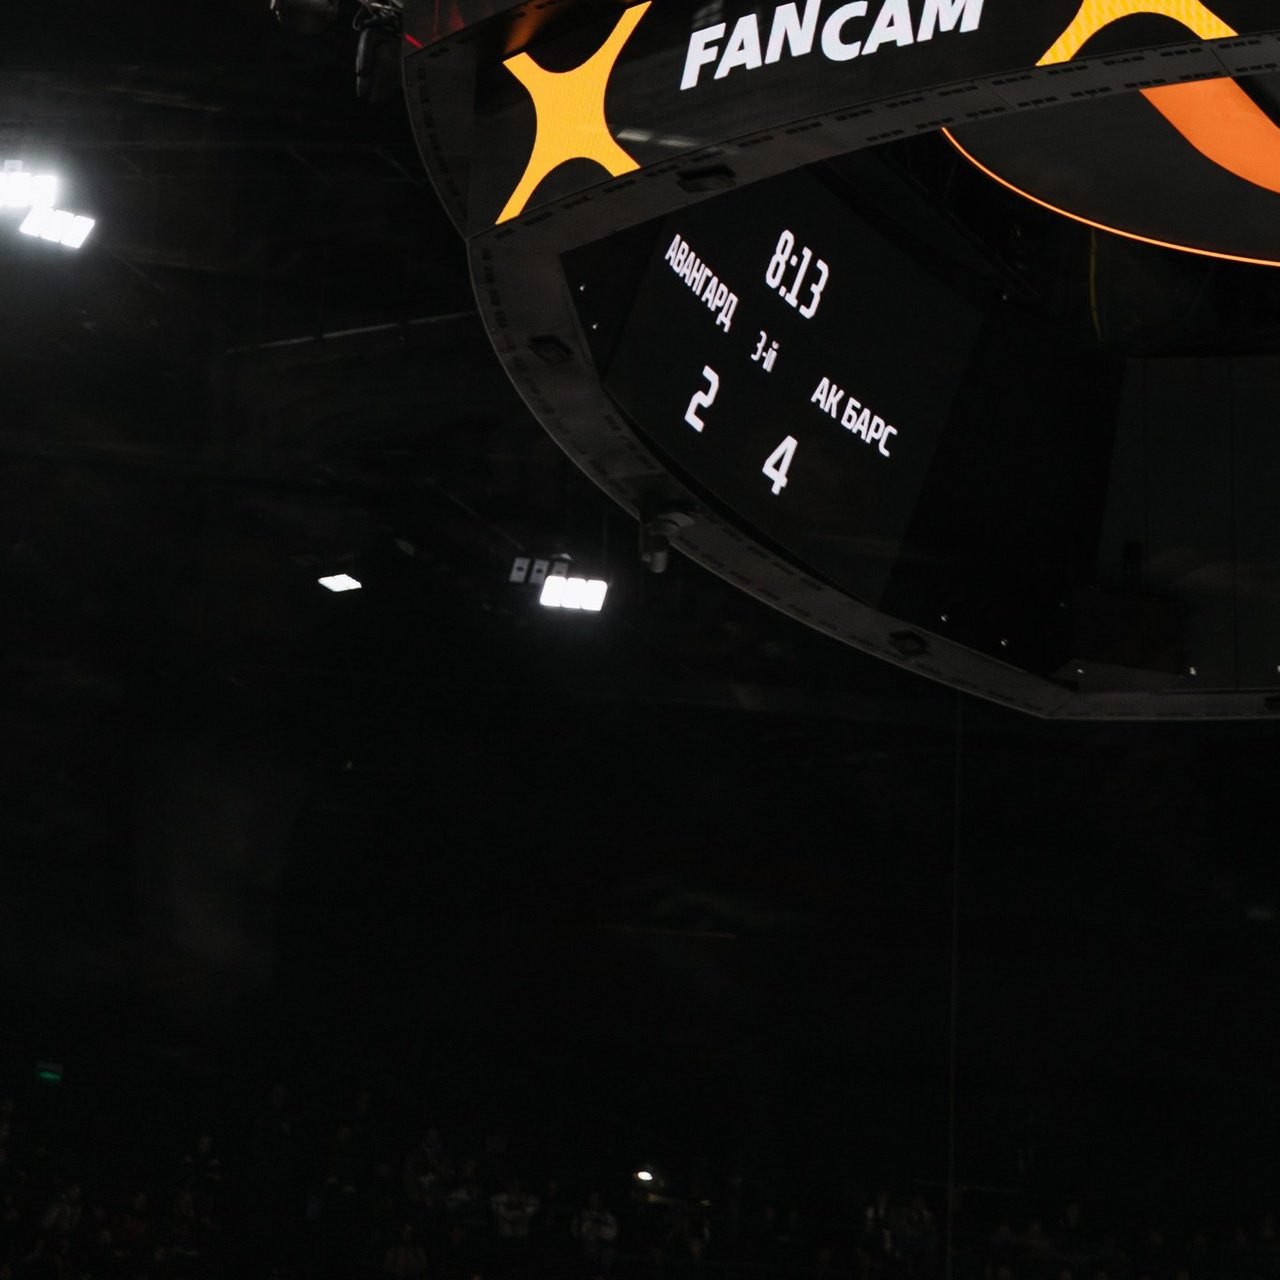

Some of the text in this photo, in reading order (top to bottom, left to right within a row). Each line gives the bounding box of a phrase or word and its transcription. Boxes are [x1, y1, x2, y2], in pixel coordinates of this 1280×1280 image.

[664, 233, 739, 333] АВАНГАРД
[765, 230, 829, 319] 8:13
[750, 330, 779, 373] 3-й
[684, 365, 719, 433] 2
[810, 376, 898, 457] АК БАРС
[761, 435, 798, 495] 4
